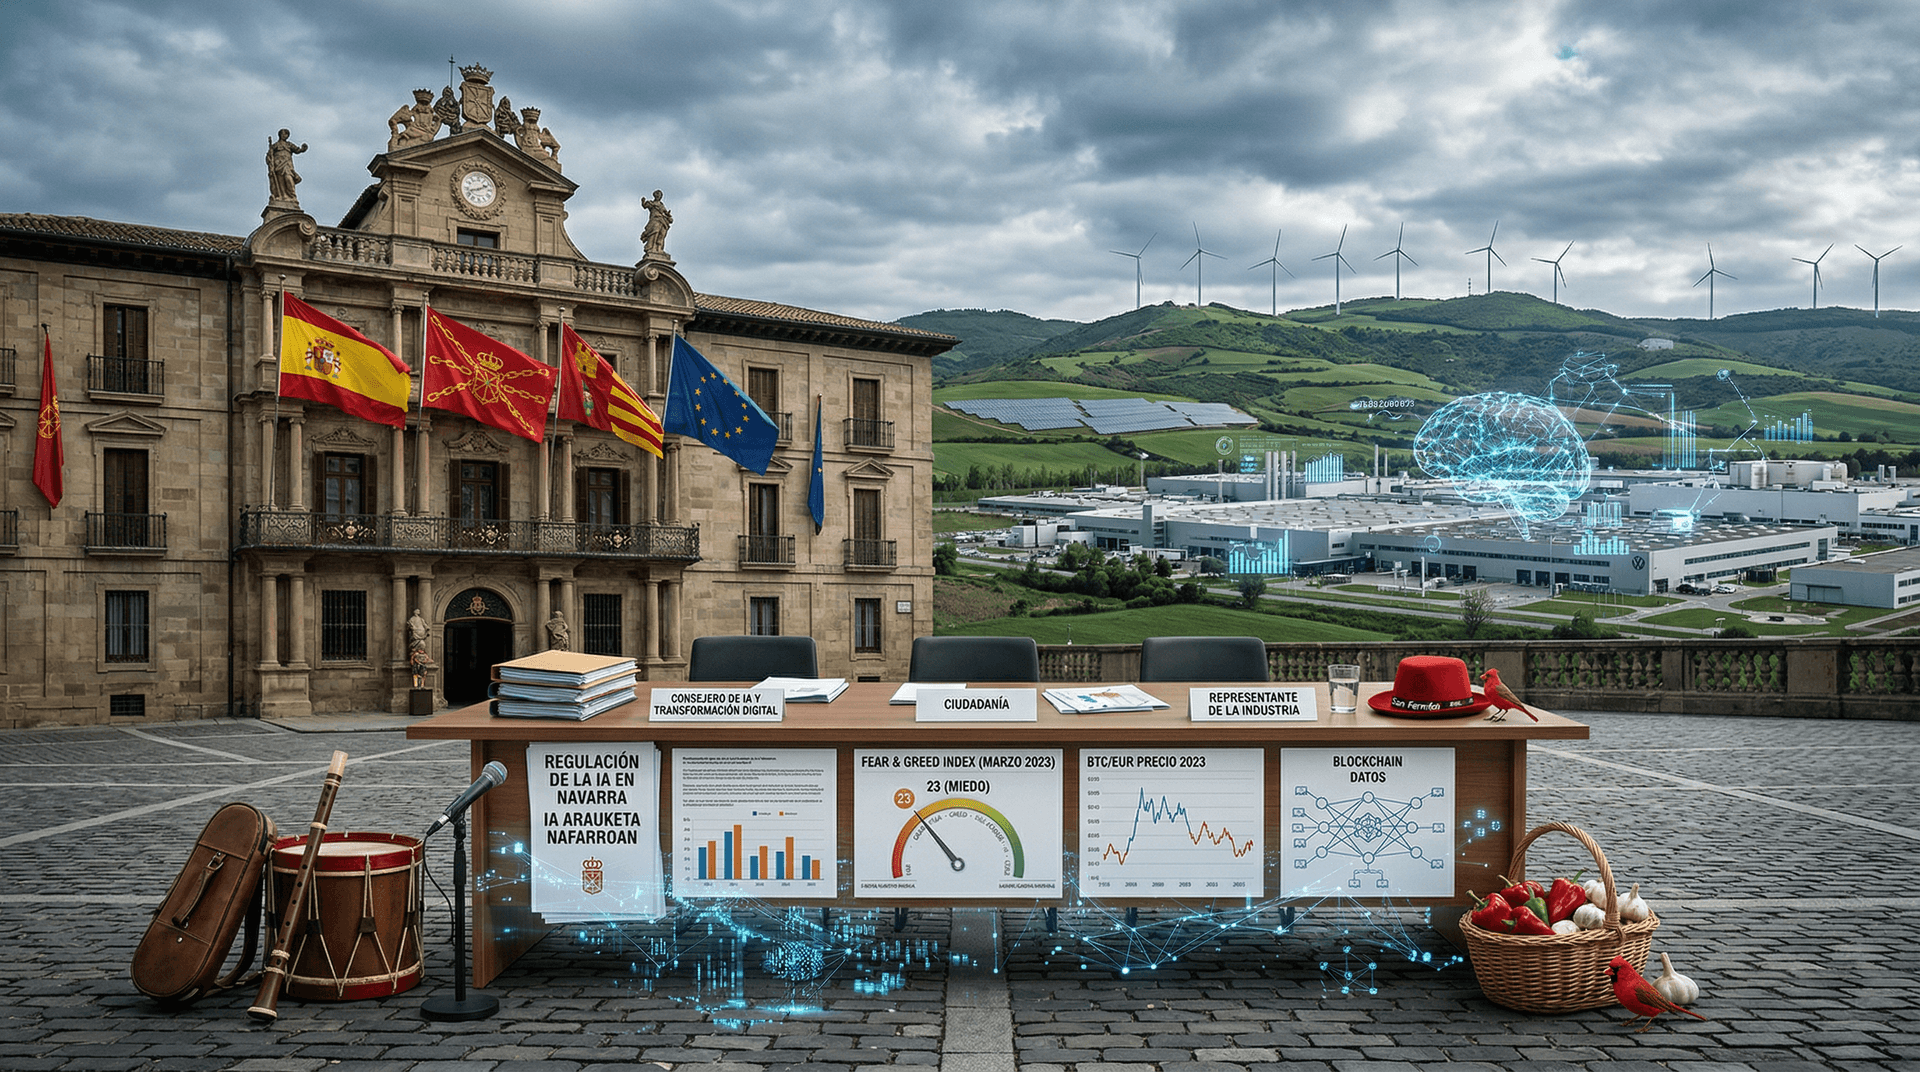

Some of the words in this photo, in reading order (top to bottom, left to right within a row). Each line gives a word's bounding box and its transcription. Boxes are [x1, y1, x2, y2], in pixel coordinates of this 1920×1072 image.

[671, 693, 726, 704] CONSEJERO
[728, 693, 740, 704] DE
[743, 693, 752, 704] IA
[754, 693, 762, 704] Y
[944, 696, 1010, 710] CIUDADANÍA
[1209, 692, 1298, 703] REPRESENTANTE
[654, 704, 740, 716] TRANSFORMACIÓN
[742, 705, 779, 716] DIGITAL
[1208, 705, 1223, 716] DE
[1225, 705, 1240, 716] LA
[1242, 704, 1300, 716] INDUSTRIA
[545, 750, 639, 769] REGULACIÓN
[861, 756, 889, 768] FEAR
[892, 756, 901, 768] &
[903, 756, 940, 768] GREED
[943, 756, 976, 768] INDEX
[978, 756, 1022, 770] (MARZO
[1024, 756, 1056, 770] 2023)
[1087, 756, 1134, 768] BTC/EUR
[1136, 756, 1177, 768] PRECIO
[1179, 756, 1206, 768] 2023
[1333, 755, 1403, 768] BLOCKCHAIN
[549, 772, 569, 787] DE
[573, 772, 592, 787] LA
[596, 772, 611, 787] IA
[615, 772, 635, 787] EN
[1350, 771, 1387, 783] DATOS
[926, 780, 941, 792] 23
[944, 780, 990, 794] (MIEDO)
[557, 790, 627, 805] NAVARRA
[897, 793, 911, 804] 23
[544, 812, 559, 827] IA
[563, 812, 641, 827] ARAUKETA
[547, 830, 638, 845] NAFARROAN
